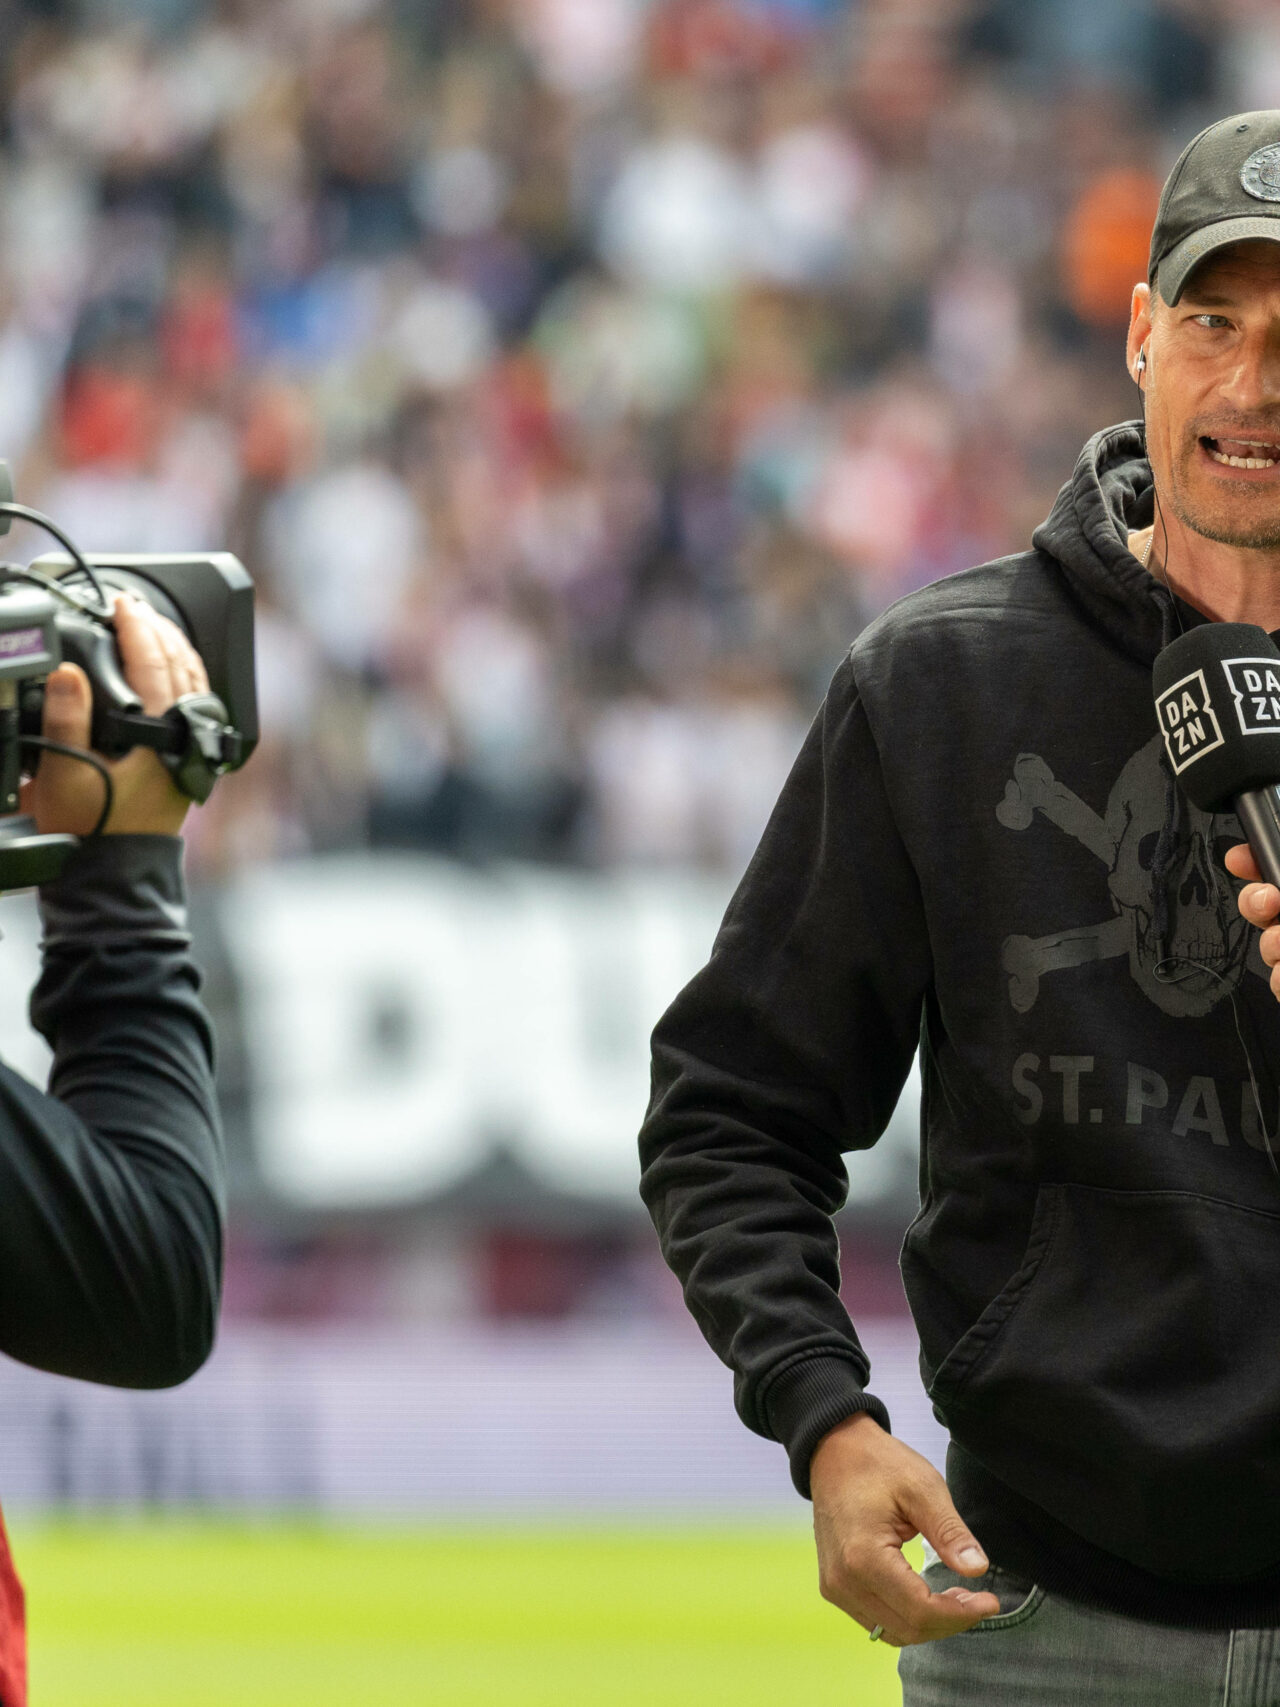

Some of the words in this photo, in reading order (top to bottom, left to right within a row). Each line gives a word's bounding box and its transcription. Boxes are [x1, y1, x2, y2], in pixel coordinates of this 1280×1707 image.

[1165, 691, 1199, 728] DA
[1173, 716, 1206, 756] ZN
[1012, 1052, 1103, 1125] ST.
